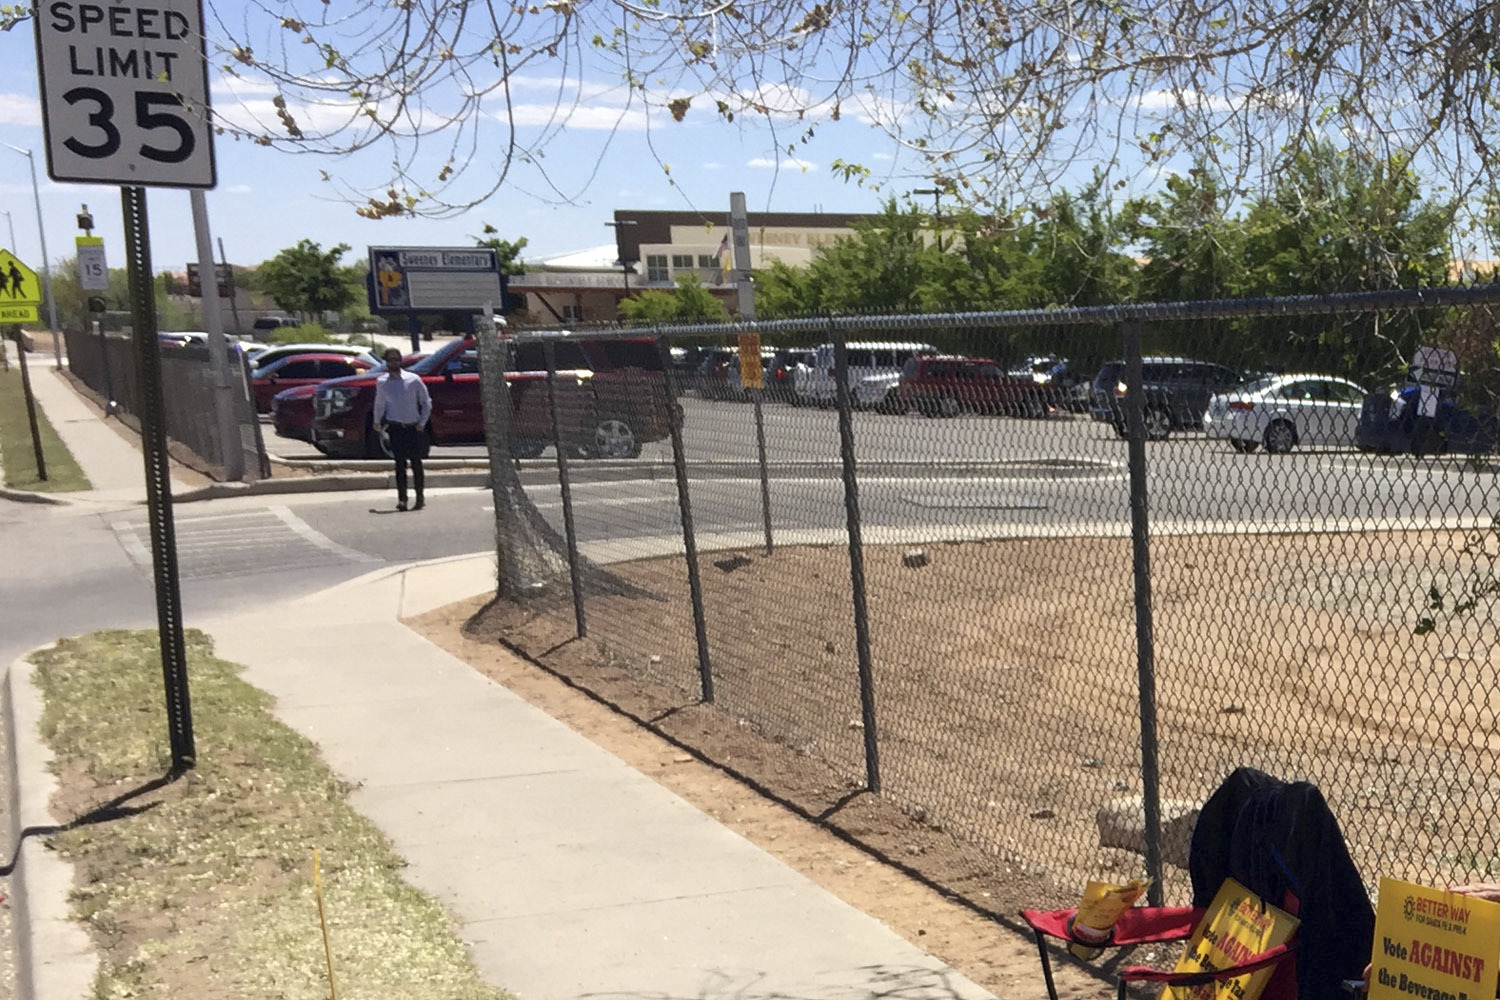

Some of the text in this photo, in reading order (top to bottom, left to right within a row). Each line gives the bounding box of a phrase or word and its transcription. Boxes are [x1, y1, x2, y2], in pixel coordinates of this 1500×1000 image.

[50, 2, 190, 40] SPEED
[69, 45, 178, 81] LIMIT
[63, 87, 195, 163] 35
[85, 264, 102, 276] 15
[1416, 897, 1471, 924] BETTER WAY
[1378, 967, 1399, 988] the
[1383, 936, 1484, 983] Vote AGAINST
